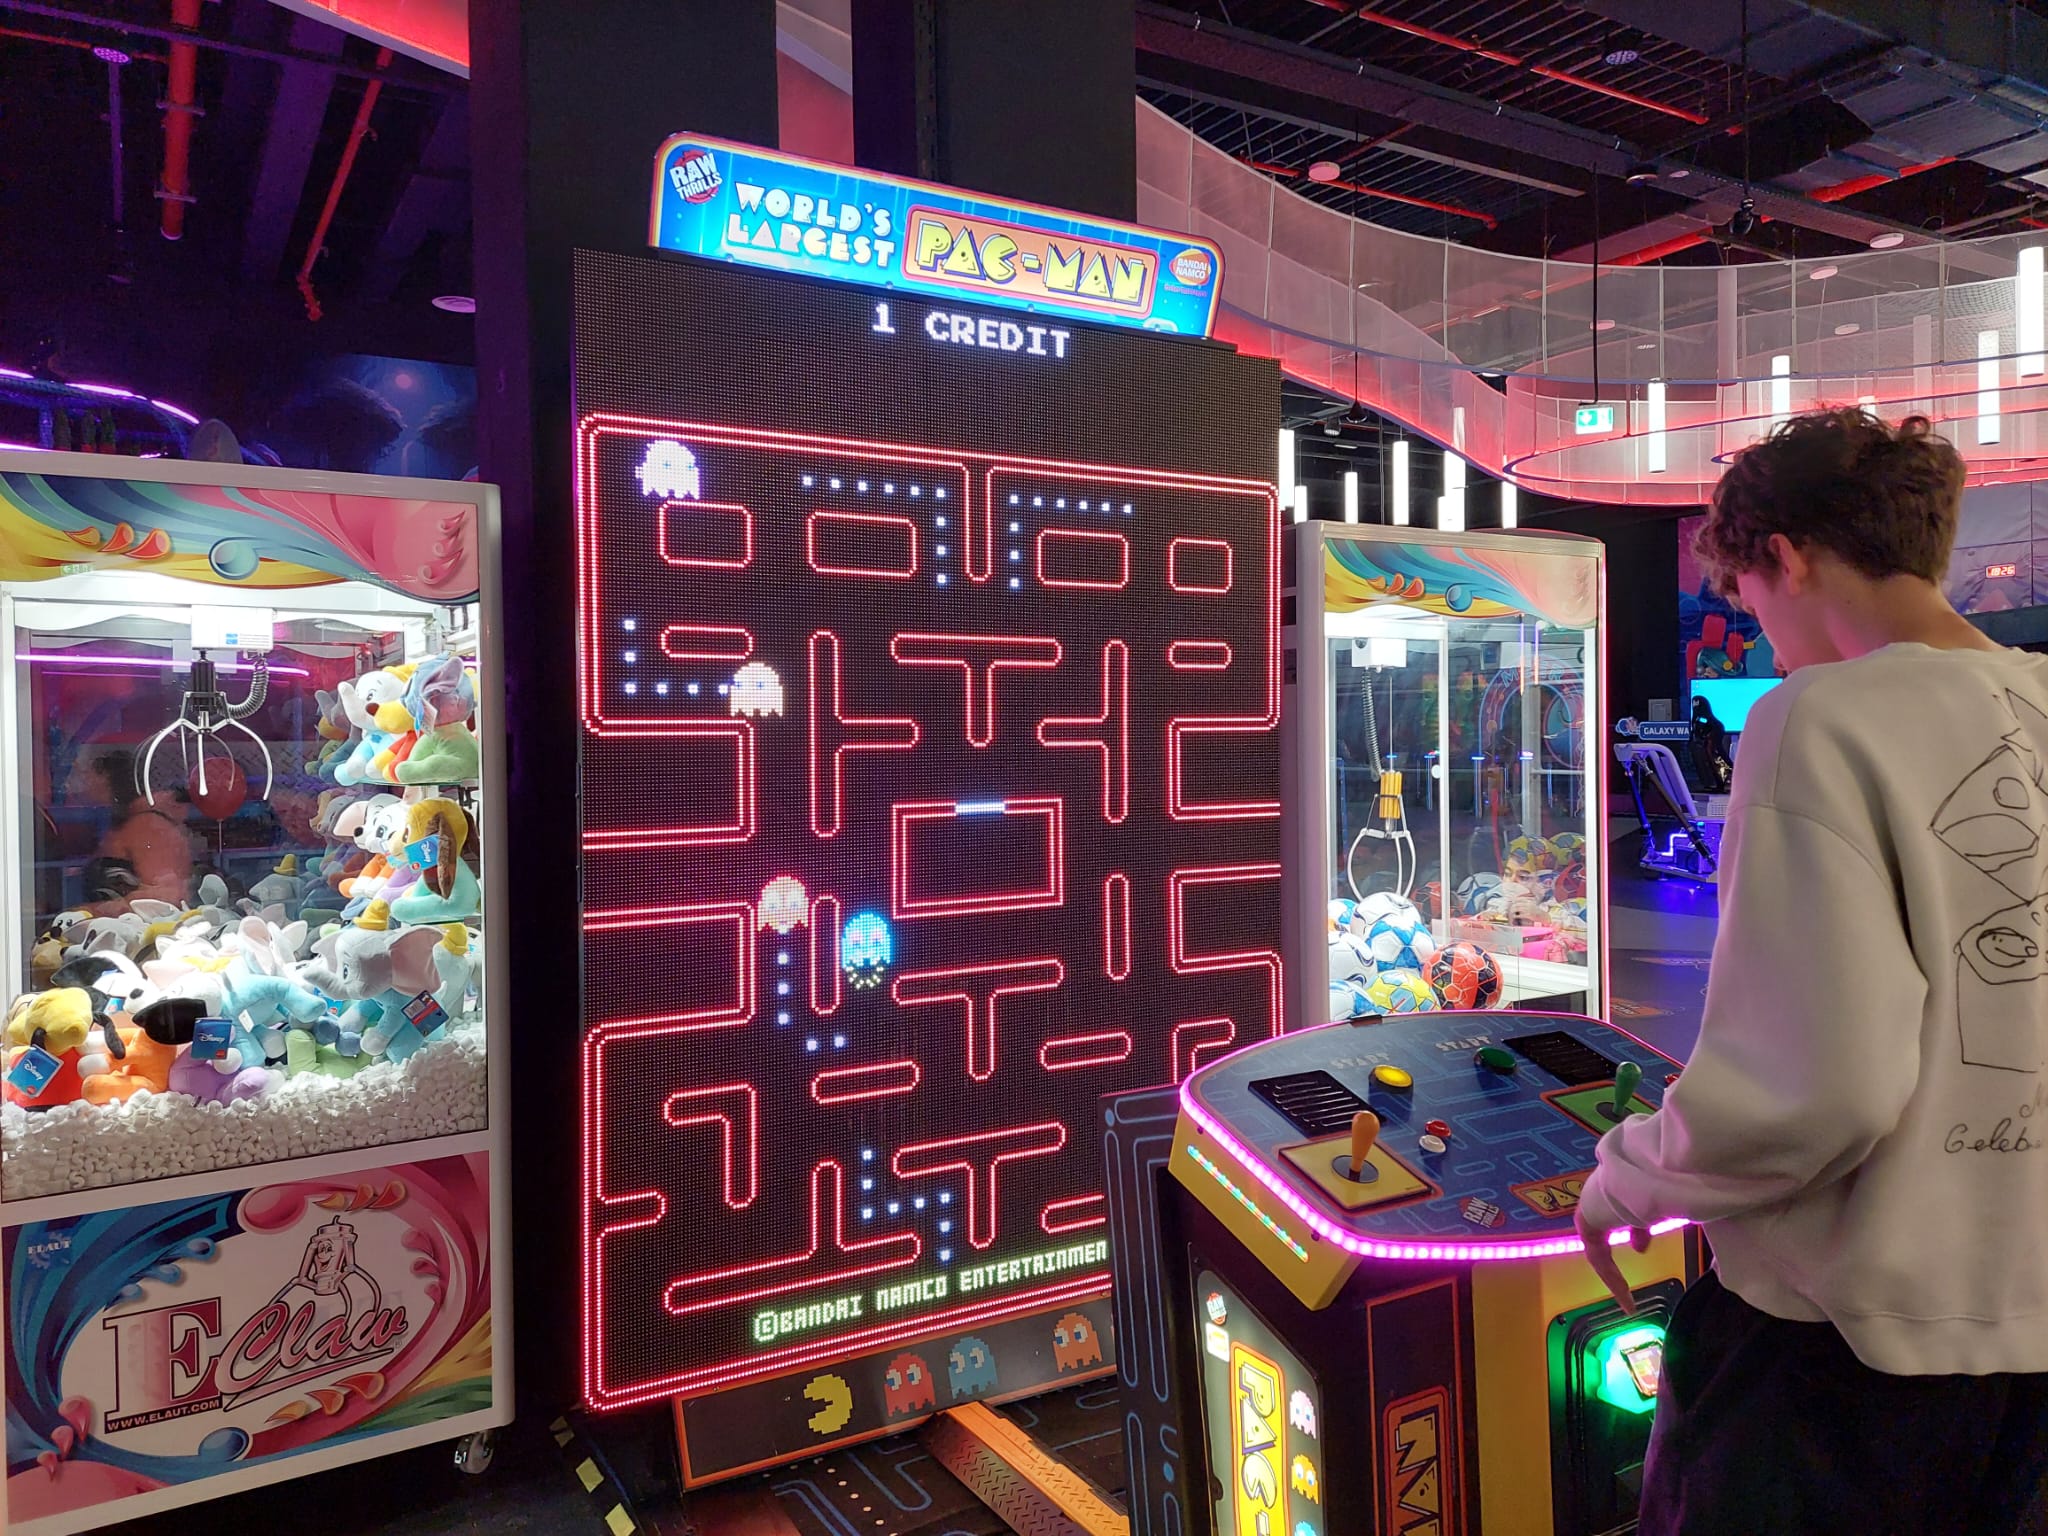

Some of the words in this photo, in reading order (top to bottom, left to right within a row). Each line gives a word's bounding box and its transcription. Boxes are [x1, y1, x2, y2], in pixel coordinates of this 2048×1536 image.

[669, 152, 717, 189] RAW
[676, 172, 723, 200] THRILLS
[734, 182, 892, 237] WORLD'S
[727, 213, 896, 268] LARGEST
[915, 218, 1148, 307] PAC-MAN
[1176, 266, 1206, 279] NAMCO
[1177, 258, 1208, 271] BANDAI
[872, 303, 896, 334] 1
[925, 311, 1070, 358] CREDIT
[1643, 727, 1674, 735] GALAXY
[1435, 1035, 1493, 1051] START
[1330, 1052, 1391, 1070] START
[1463, 1197, 1489, 1224] RAW
[876, 1275, 948, 1312] NAMCO
[107, 1400, 220, 1432] WWW.ELAUT.COM
